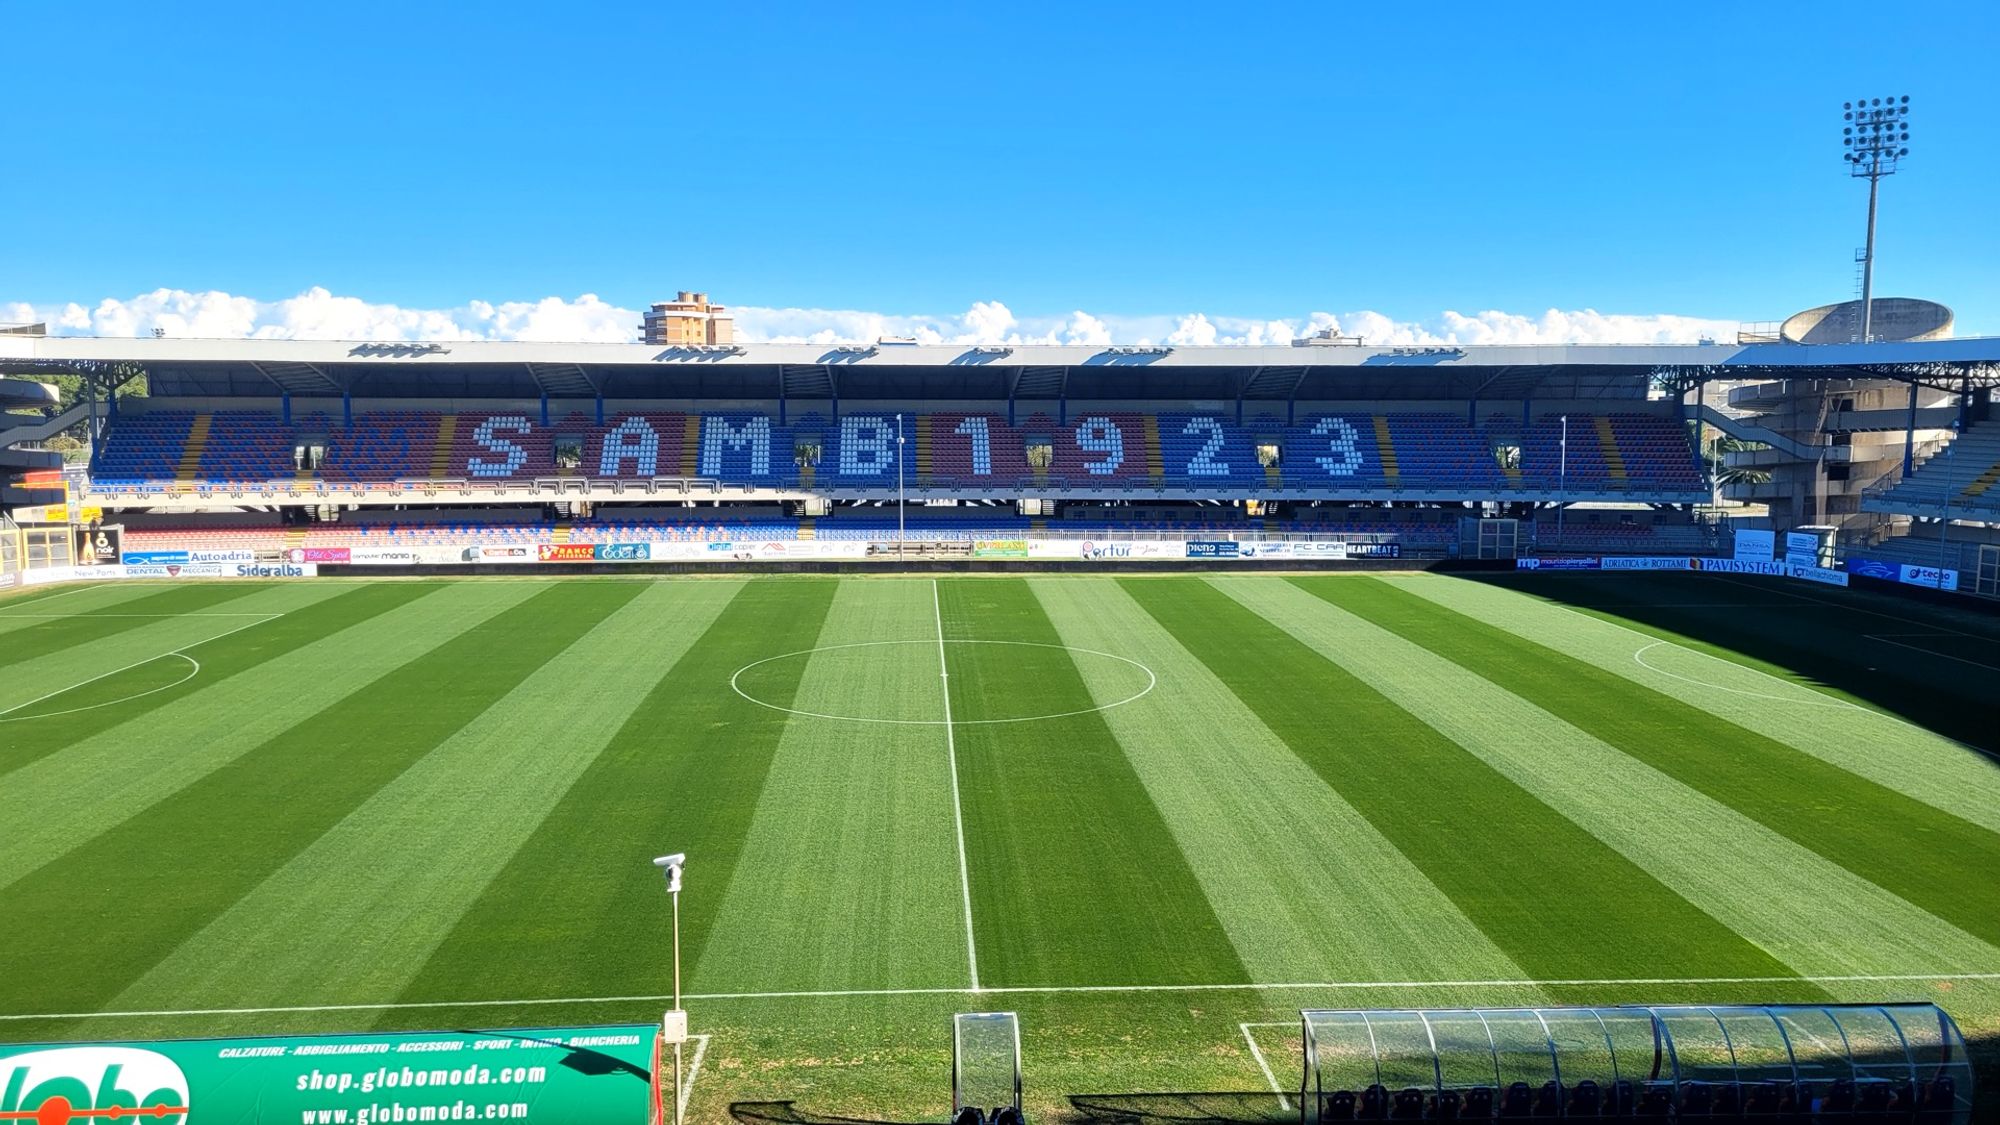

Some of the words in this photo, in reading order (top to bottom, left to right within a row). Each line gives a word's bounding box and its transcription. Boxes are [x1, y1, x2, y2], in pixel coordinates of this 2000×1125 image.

[1346, 545, 1392, 554] HEARTBEAT
[191, 551, 252, 562] Autoadria
[381, 552, 410, 560] mania
[1517, 558, 1540, 569] mp
[1604, 559, 1640, 567] ADRIATICA
[1651, 559, 1686, 567] ROTTAMI
[1706, 559, 1780, 575] PAVISYSTEM
[237, 565, 303, 576] Sideralba
[219, 1046, 287, 1058] CALZATURE
[294, 1043, 390, 1056] ABBIGLIAMENTO
[397, 1041, 464, 1053] ACCESSORI
[474, 1039, 513, 1050] SPORT
[521, 1036, 567, 1048] INTIMO
[569, 1035, 640, 1047] BIANCHERIA
[296, 1064, 546, 1093] shop.globomoda.com
[0, 1063, 185, 1125] lobo
[302, 1100, 528, 1125] www.globomoda.com
